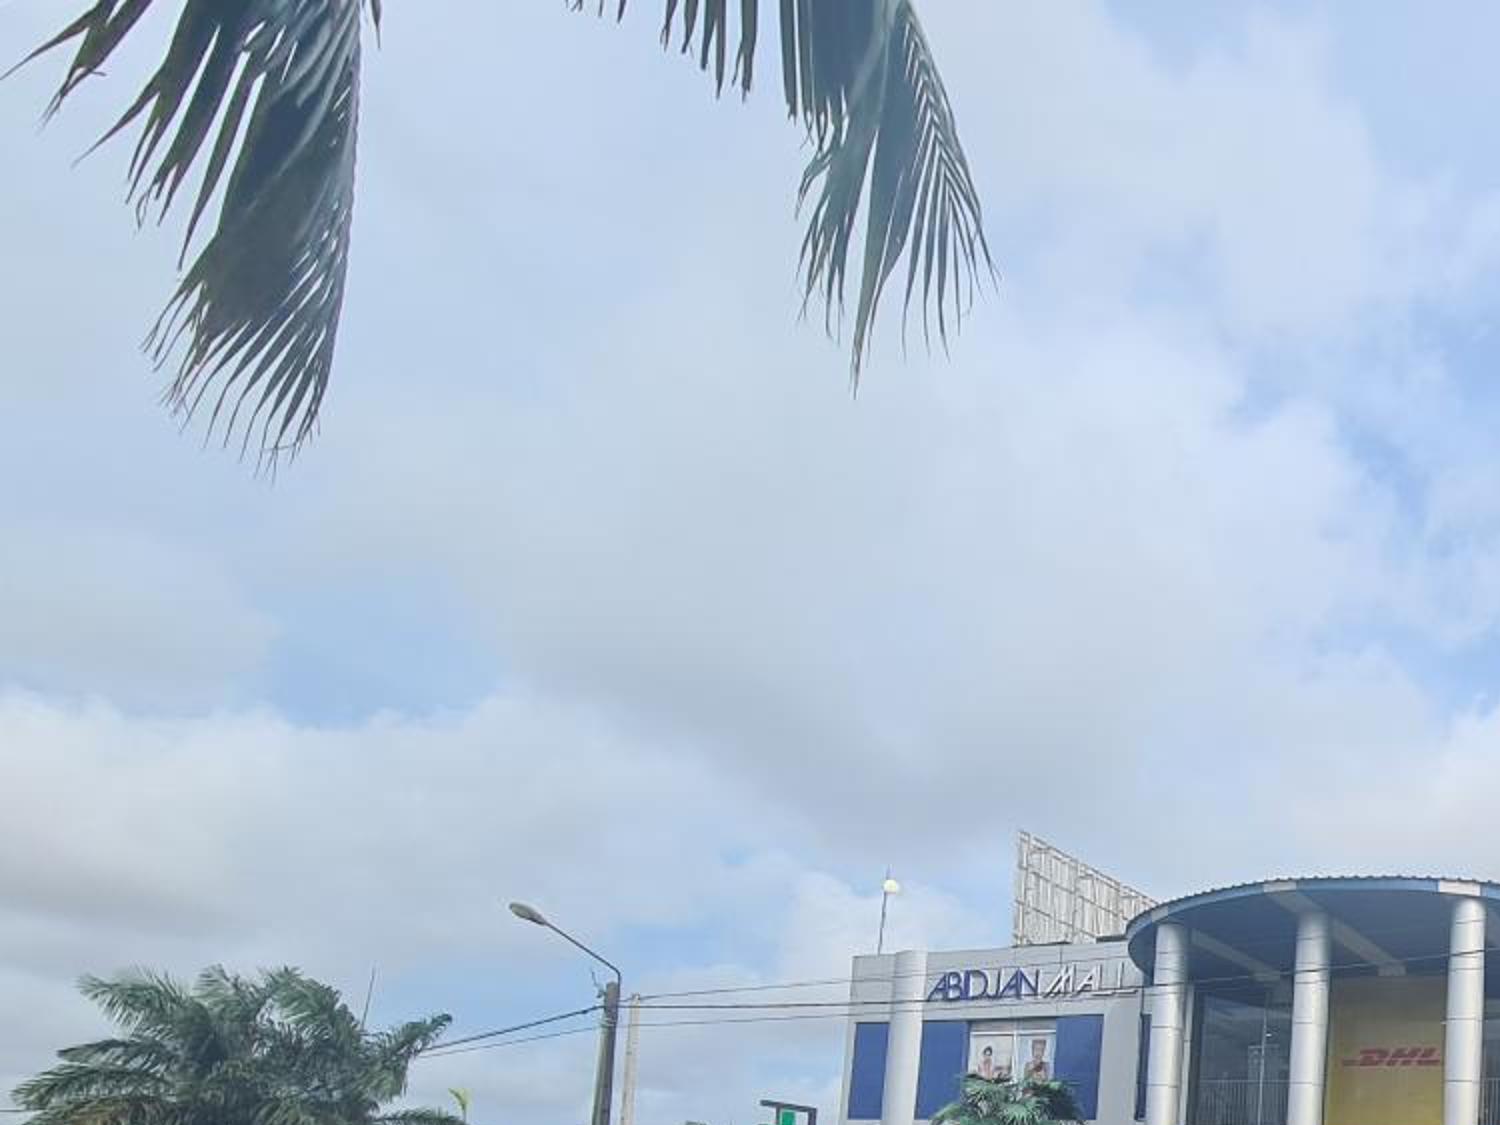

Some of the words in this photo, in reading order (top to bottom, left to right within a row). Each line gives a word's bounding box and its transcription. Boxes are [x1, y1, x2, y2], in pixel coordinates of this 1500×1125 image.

[928, 968, 1041, 1001] ABIDJAN
[1043, 961, 1139, 998] MALL
[1357, 1047, 1441, 1067] DHL
